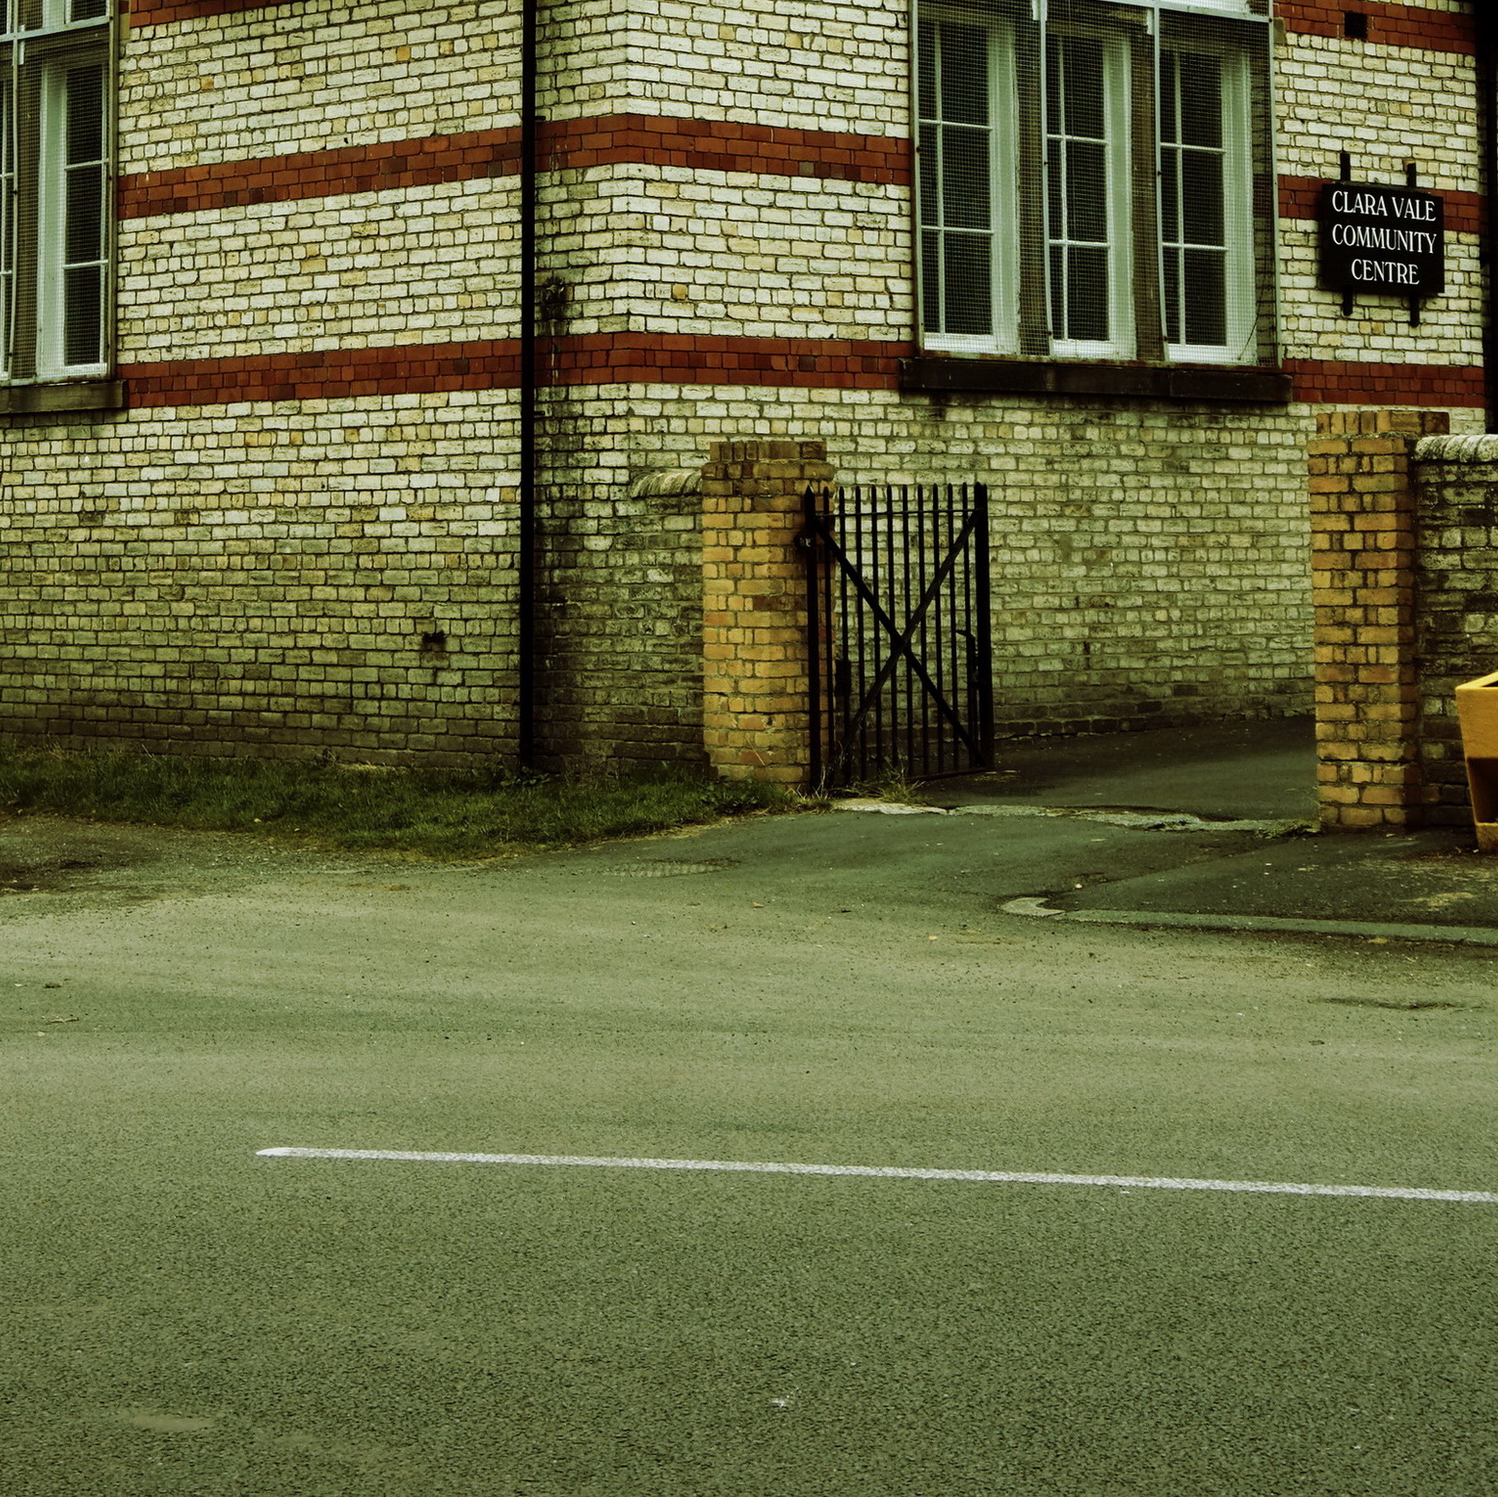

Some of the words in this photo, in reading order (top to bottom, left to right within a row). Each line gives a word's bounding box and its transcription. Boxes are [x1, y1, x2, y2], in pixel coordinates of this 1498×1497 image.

[1332, 190, 1388, 217] CLARA
[1391, 196, 1437, 222] VALE
[1332, 223, 1437, 254] COMMUNITY
[1351, 258, 1420, 285] CENTRE
